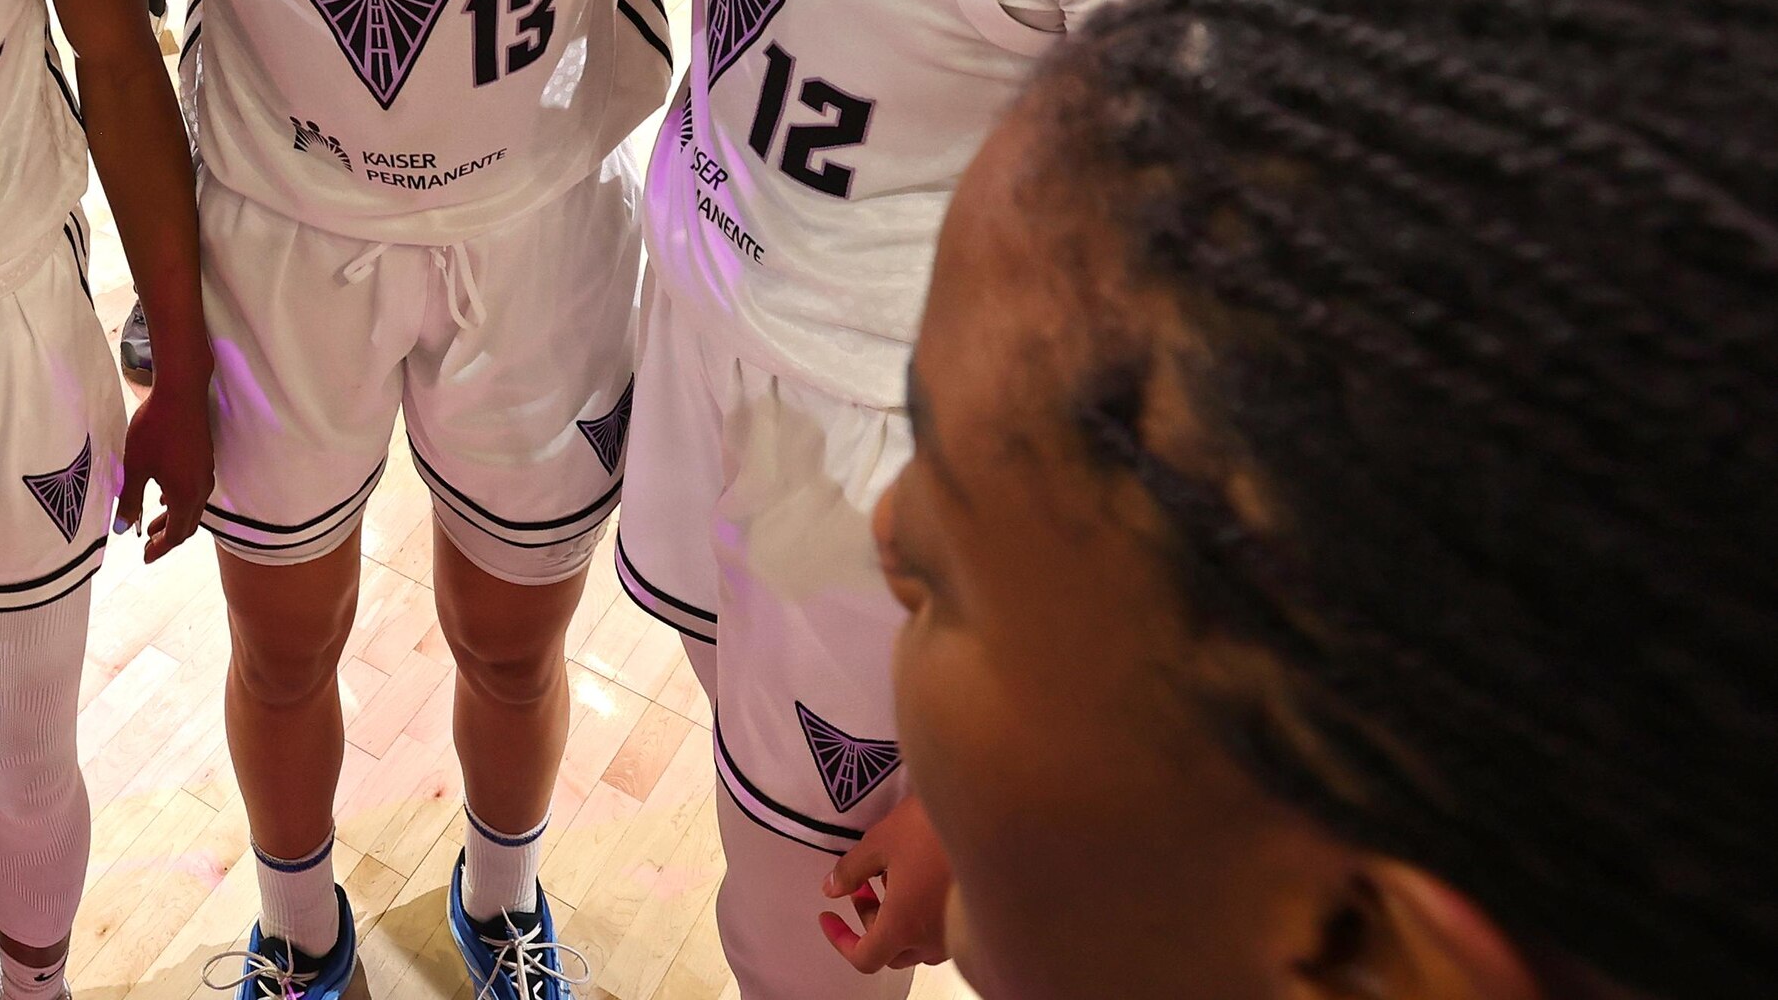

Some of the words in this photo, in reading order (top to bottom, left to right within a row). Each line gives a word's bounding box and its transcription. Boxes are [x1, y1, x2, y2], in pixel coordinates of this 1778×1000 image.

[748, 39, 877, 200] 12
[362, 151, 436, 169] KAISER
[366, 148, 507, 190] PERMANENTE
[697, 189, 765, 265] ANENTE
